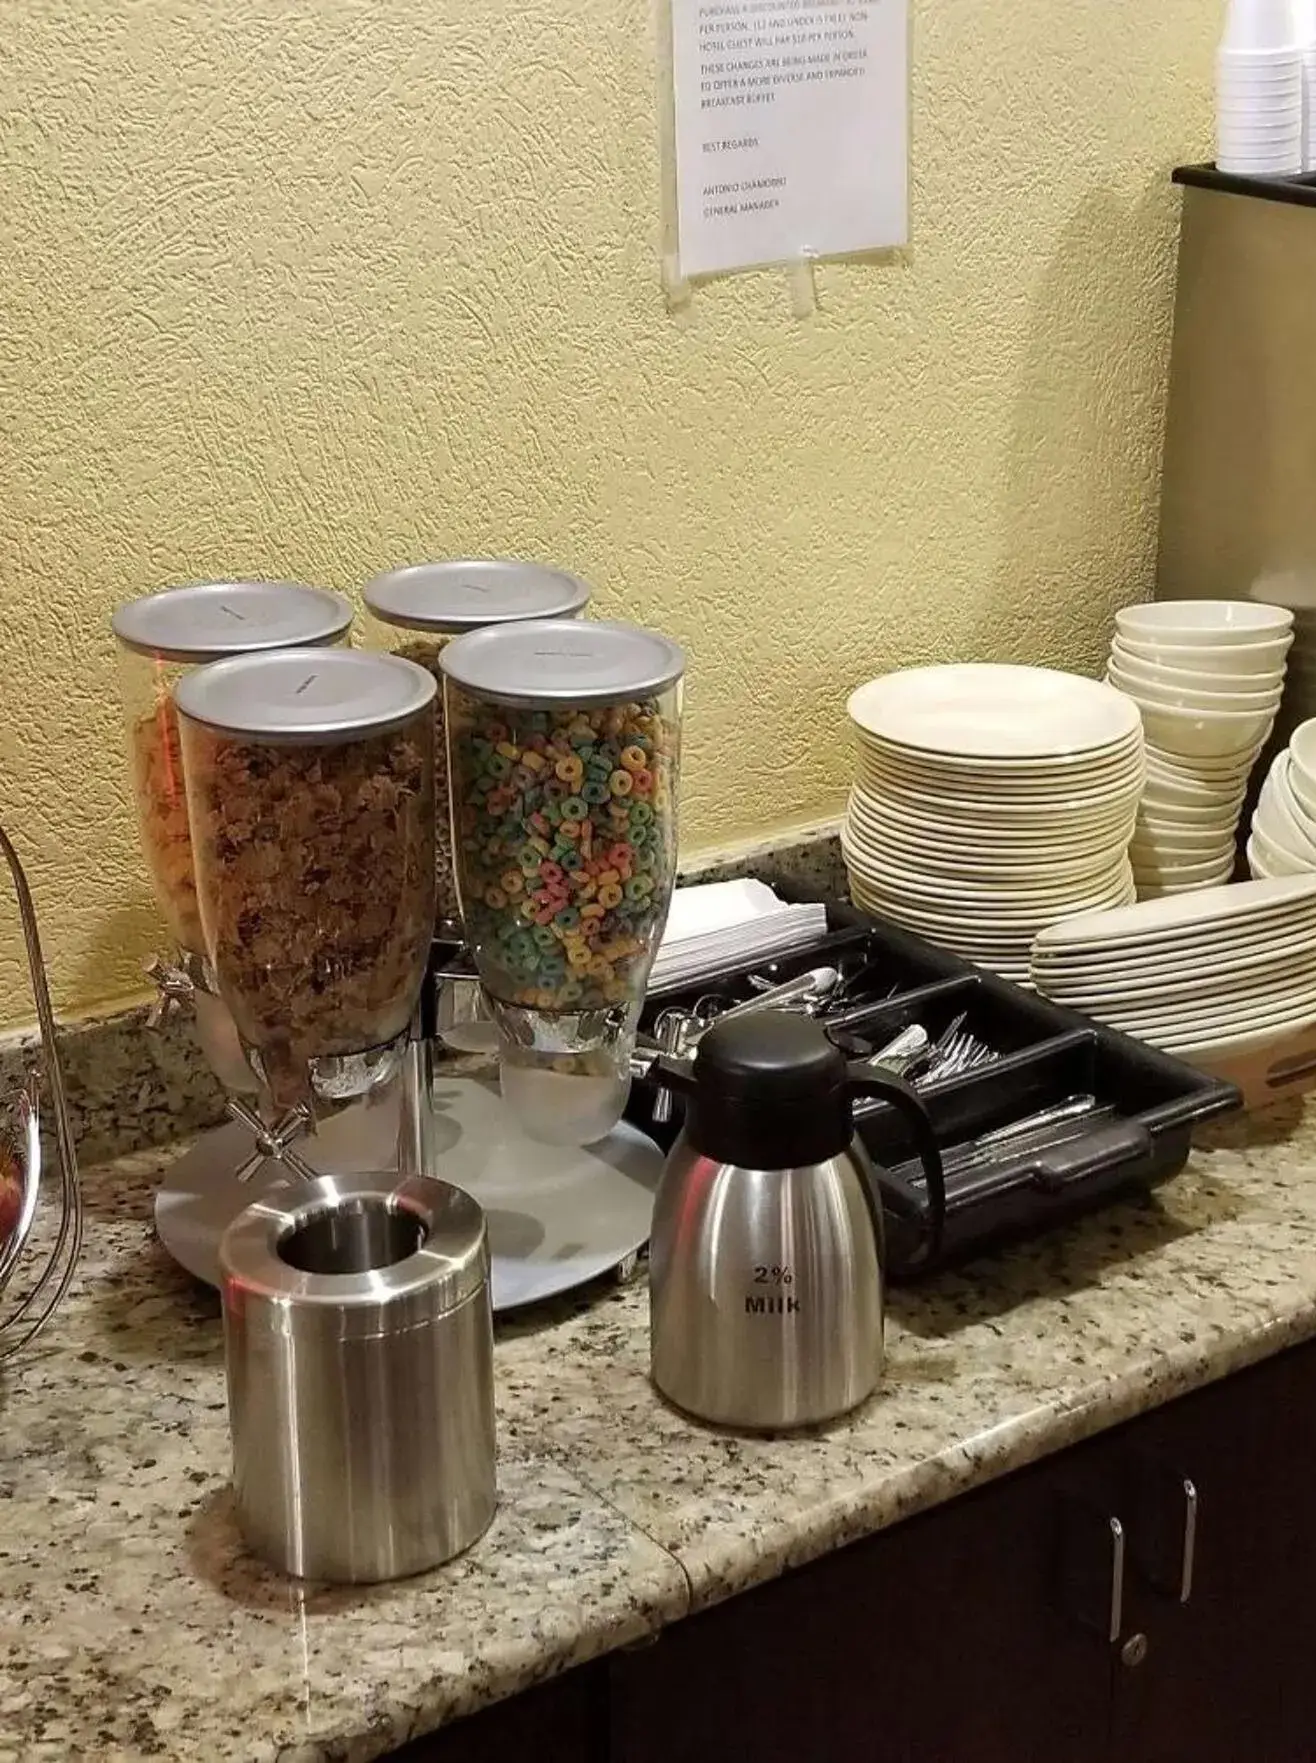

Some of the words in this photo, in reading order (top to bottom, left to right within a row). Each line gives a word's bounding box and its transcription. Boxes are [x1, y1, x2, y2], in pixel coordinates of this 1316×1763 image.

[701, 63, 724, 75] THESE
[726, 60, 764, 72] CHANGES
[765, 58, 780, 68] ARE
[747, 76, 771, 87] MORE
[806, 70, 823, 81] AND
[701, 96, 746, 109] BREAKFAST
[702, 183, 739, 196] ANTONIO
[703, 204, 738, 218] GENERAL
[739, 199, 780, 212] MANAGER
[753, 1265, 793, 1286] 2%
[745, 1295, 801, 1314] Milk
